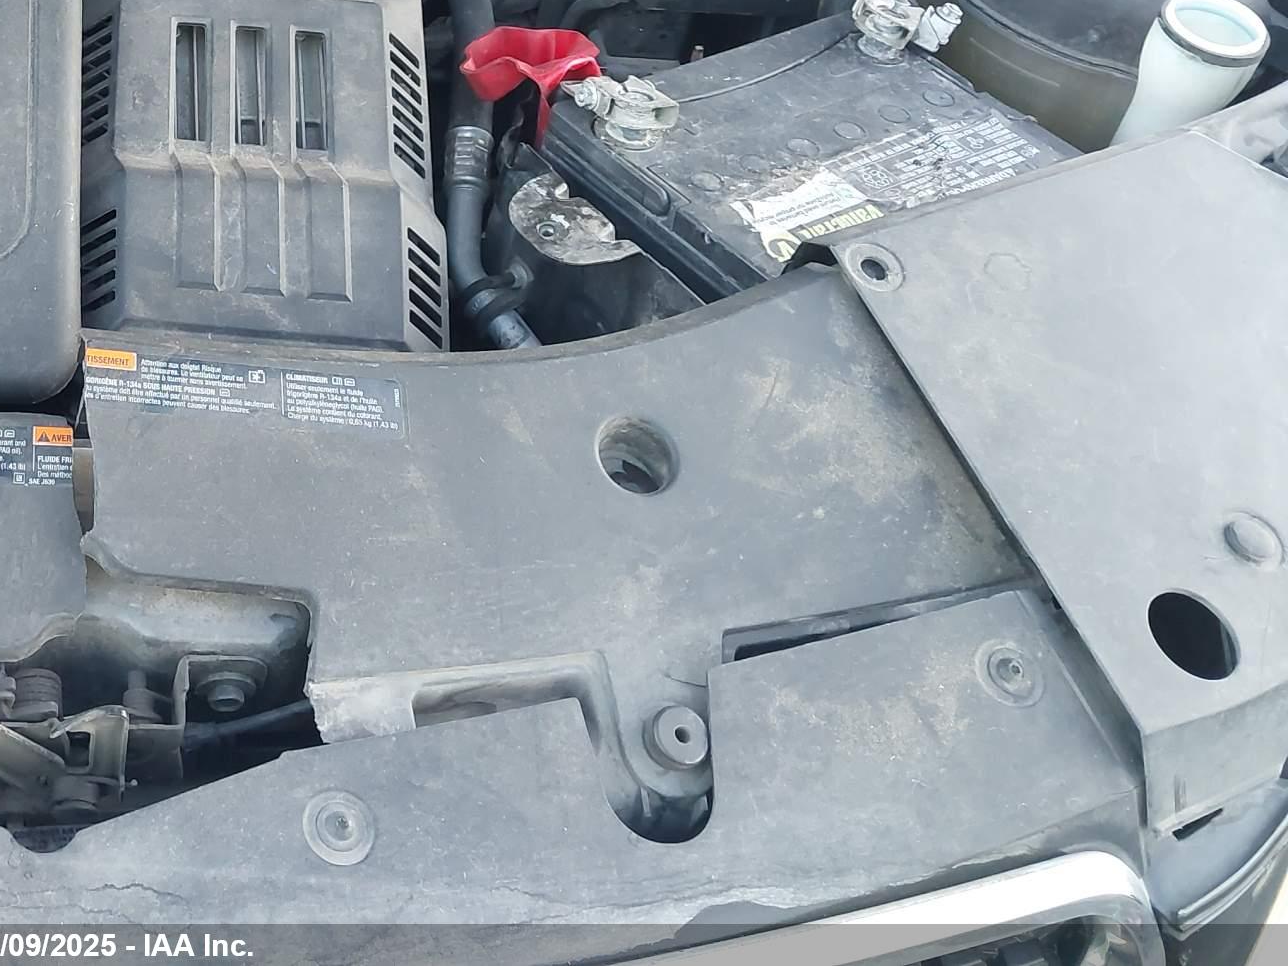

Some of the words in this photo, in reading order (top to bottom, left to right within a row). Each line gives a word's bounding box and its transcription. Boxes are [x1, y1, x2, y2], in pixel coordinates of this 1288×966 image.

[87, 354, 129, 365] TISSEMENT
[286, 373, 328, 384] CLIMATISEUR
[119, 380, 141, 388] R-134a
[143, 382, 160, 390] SOUS
[161, 383, 182, 392] HAUTE
[183, 386, 215, 395] PRESSION
[320, 392, 342, 401] R-134a
[350, 395, 358, 403] de
[287, 412, 308, 421] Charge
[319, 415, 344, 424] système
[364, 420, 372, 428] kg
[390, 421, 398, 430] lb)
[50, 434, 72, 442] AVER
[37, 455, 60, 463] FLUIDE
